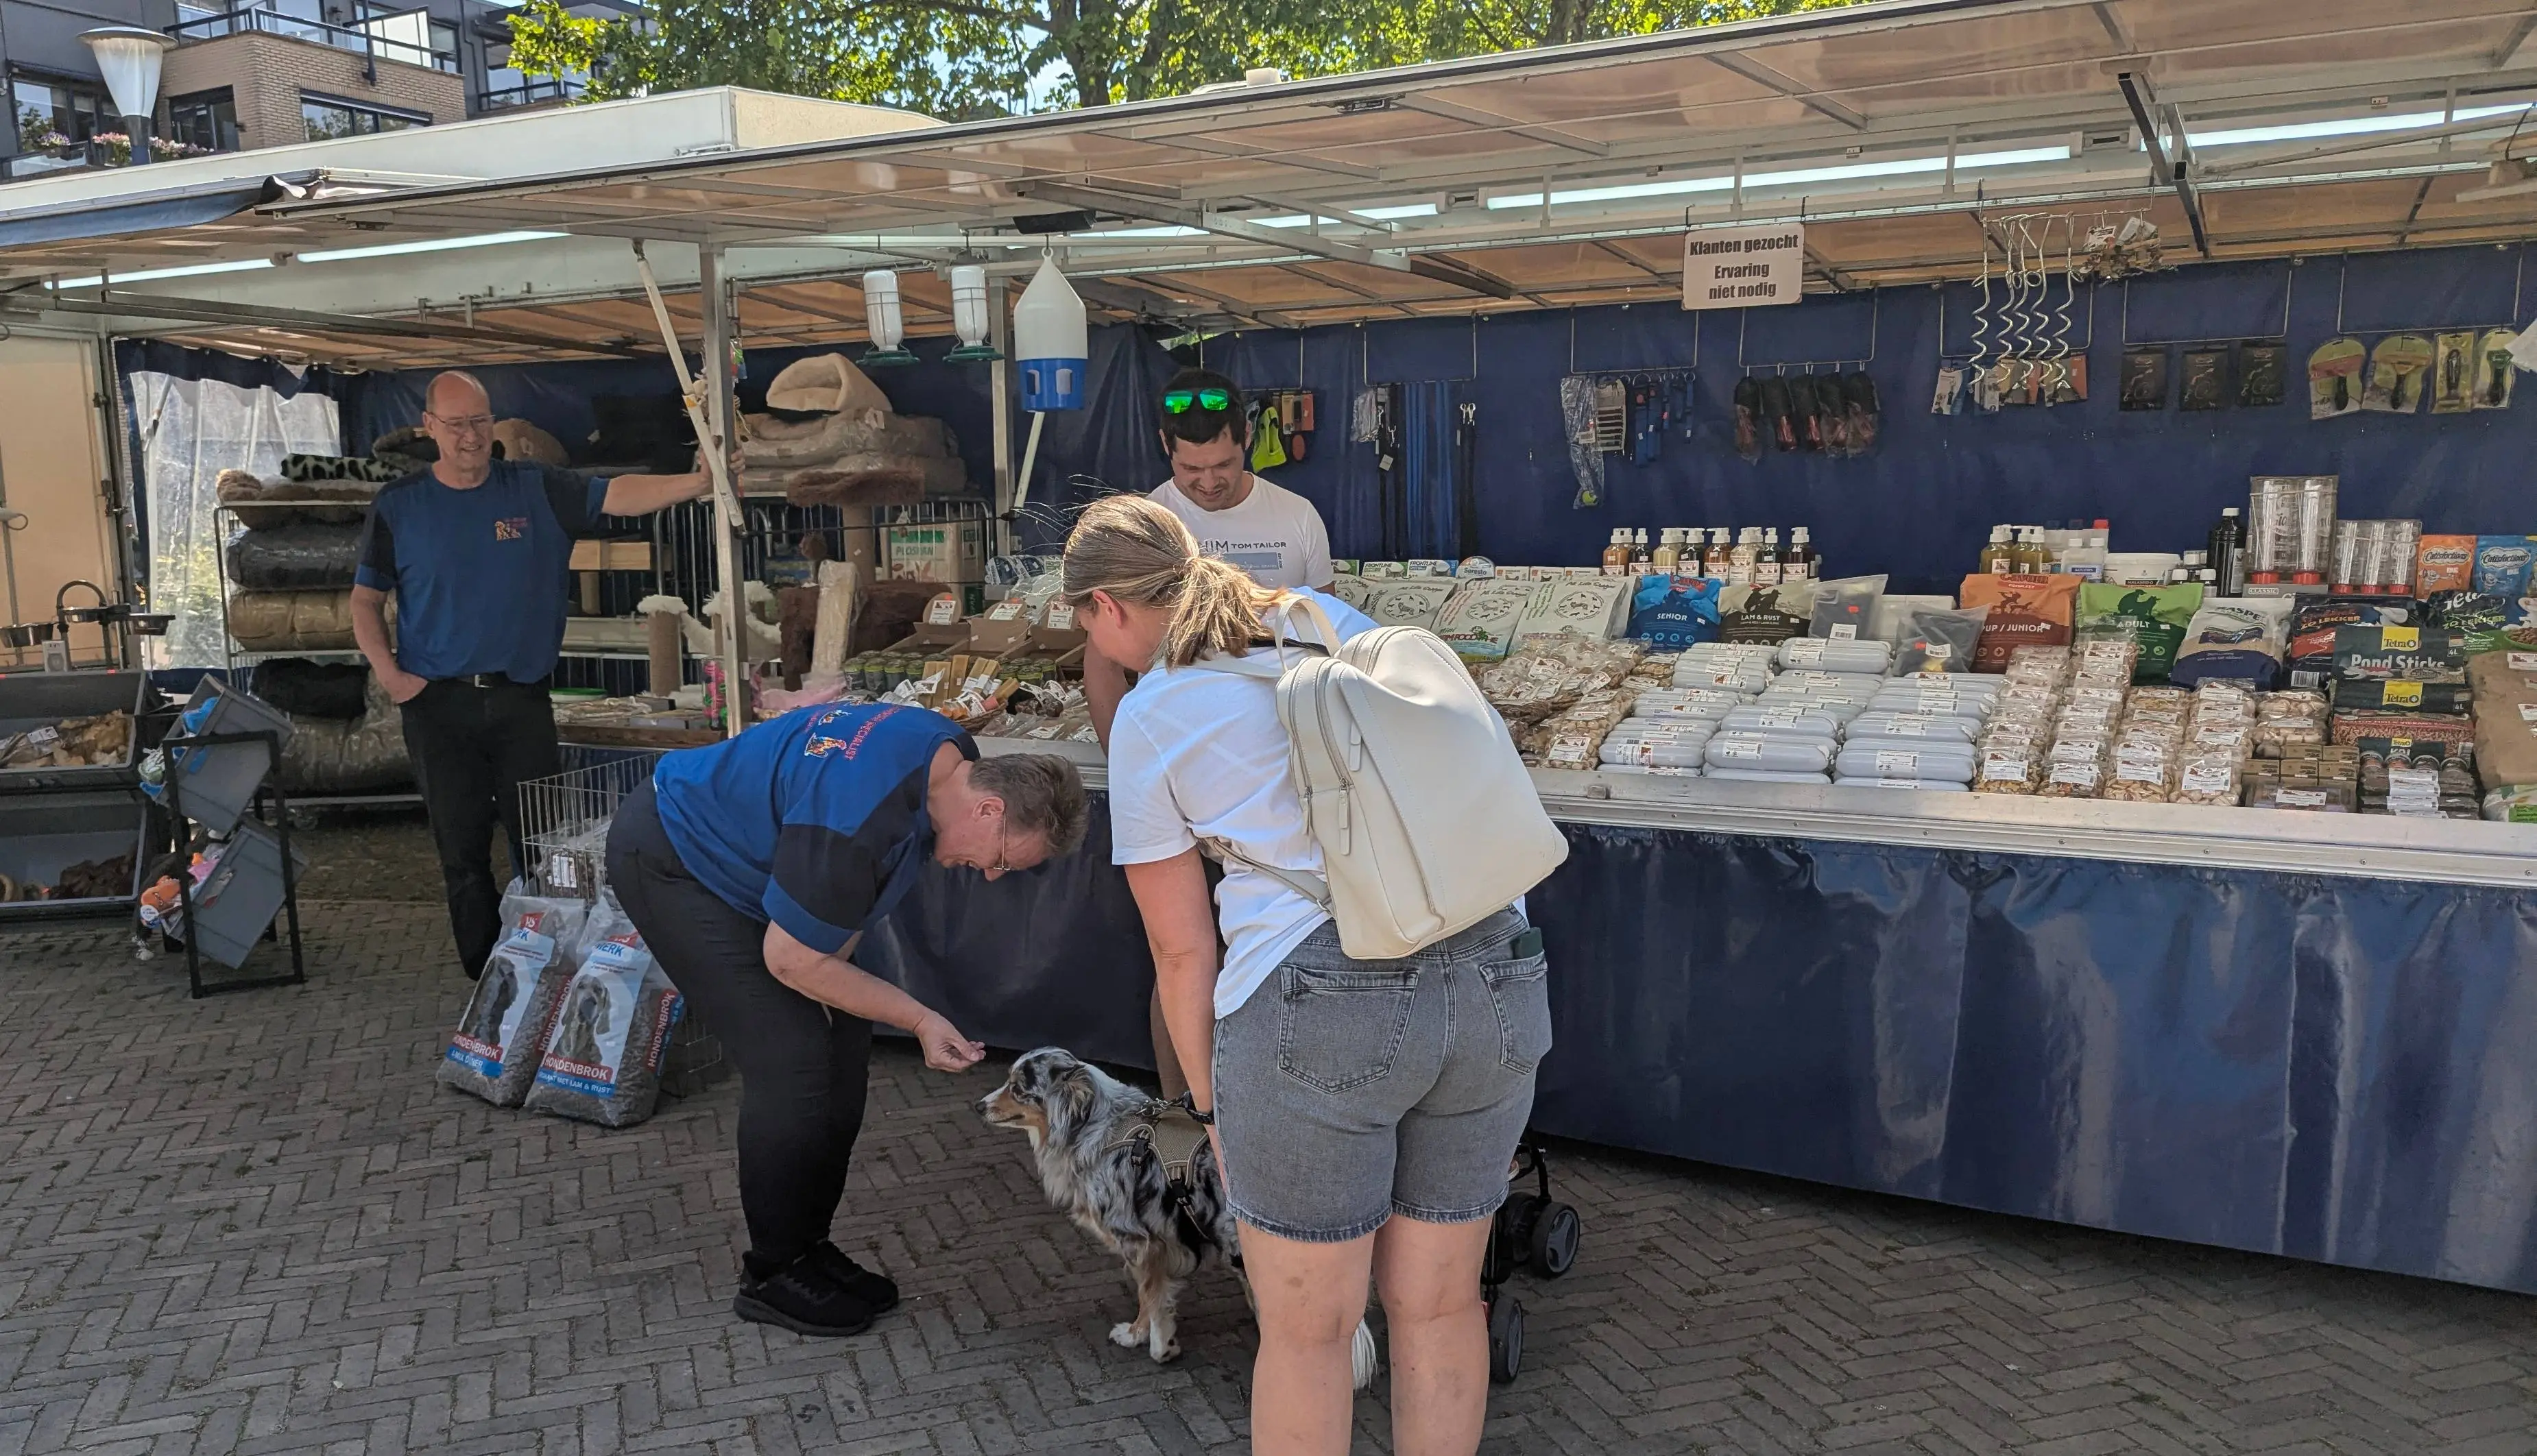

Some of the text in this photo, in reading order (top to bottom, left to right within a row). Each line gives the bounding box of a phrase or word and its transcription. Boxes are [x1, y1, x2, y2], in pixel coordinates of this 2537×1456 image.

[1690, 234, 1798, 256] Klanten gezocht
[1714, 263, 1770, 279] Ervaring
[1709, 282, 1777, 300] niet nodig
[1657, 613, 1687, 621] SENIOR
[2007, 623, 2043, 633] JUNIOR
[2384, 638, 2406, 648] Tetra
[2351, 654, 2444, 668] Pond Sticks
[2385, 694, 2409, 703] Tetra
[647, 993, 675, 1067] HONDENBROK
